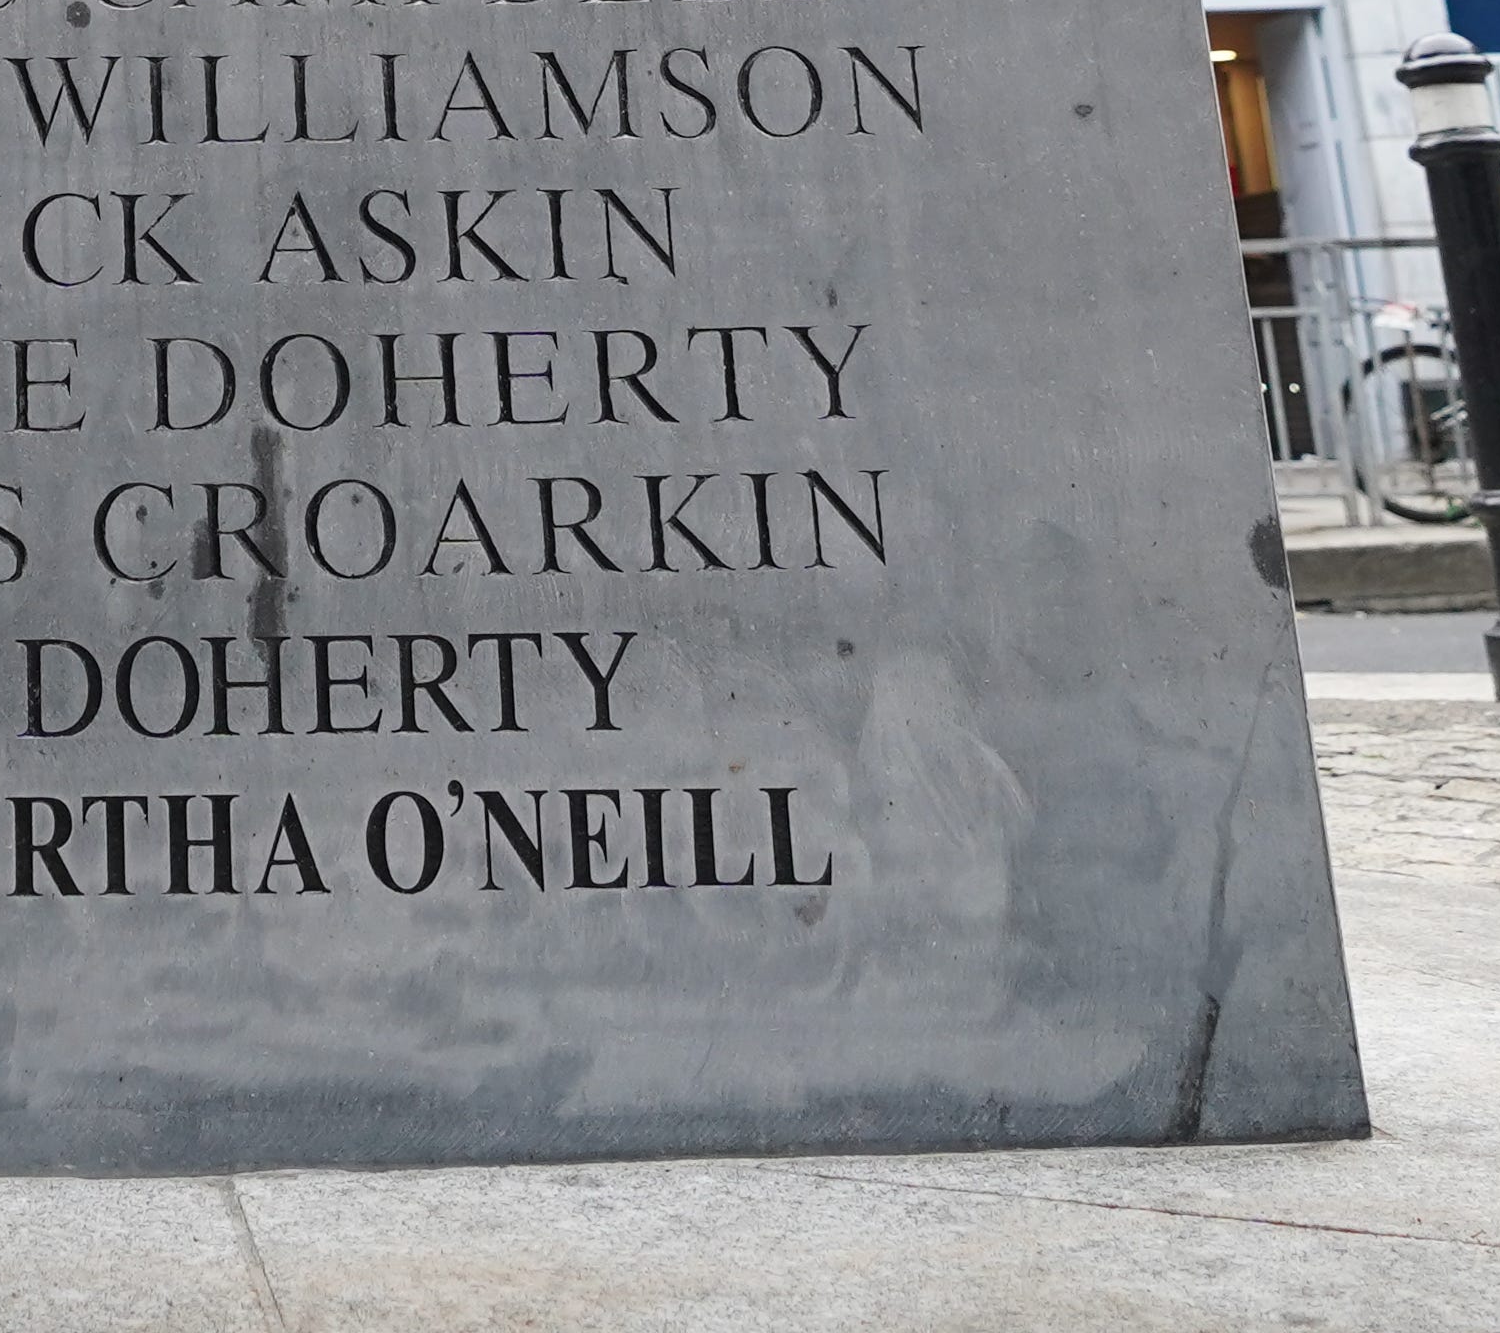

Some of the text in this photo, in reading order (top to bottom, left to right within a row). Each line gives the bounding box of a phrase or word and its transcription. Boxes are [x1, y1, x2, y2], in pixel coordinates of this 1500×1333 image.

[2, 44, 930, 147] WILLIAMSON
[254, 186, 680, 285] ASKIN
[147, 326, 871, 433] DOHERTY
[91, 469, 893, 580] CROARKIN
[18, 631, 638, 739] DOHERTY
[365, 787, 836, 895] O'NEILL
